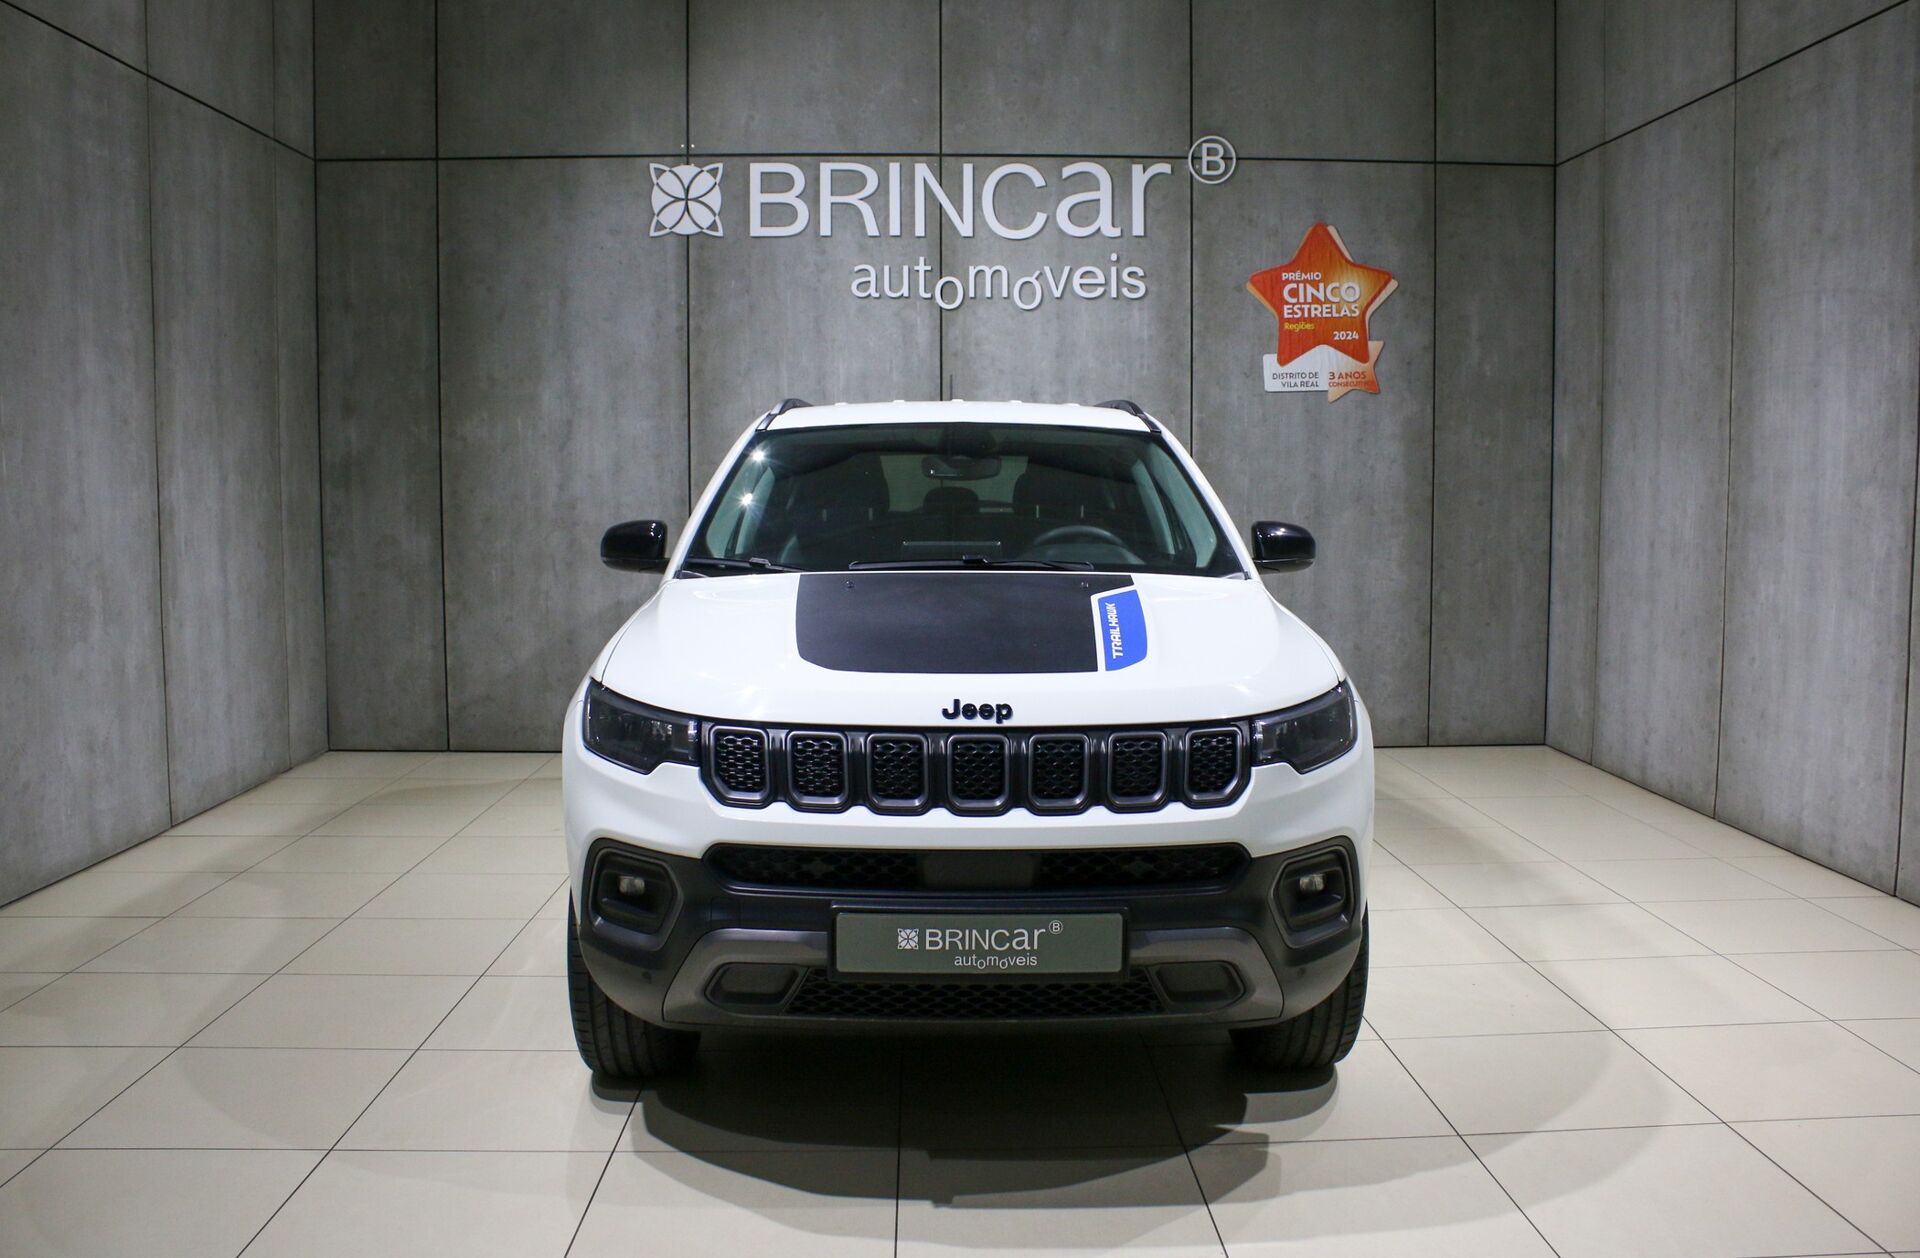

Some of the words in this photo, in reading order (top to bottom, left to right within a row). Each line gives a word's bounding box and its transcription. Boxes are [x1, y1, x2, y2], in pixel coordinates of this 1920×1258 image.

[749, 161, 1172, 239] BRINCar
[1282, 270, 1321, 280] PRÉMIO
[1283, 282, 1360, 303] CINCO
[1283, 303, 1360, 318] ESTRELAS
[1333, 331, 1359, 340] 2024
[1272, 372, 1308, 380] DISTRITO
[1308, 371, 1320, 379] DE
[1328, 371, 1336, 381] 3
[1337, 370, 1368, 380] ANOS
[1281, 380, 1299, 388] VILA
[1300, 380, 1320, 388] REAL
[1104, 602, 1124, 660] TRAILHAWK
[941, 698, 1014, 725] Jeep
[925, 927, 1046, 951] BRINCar
